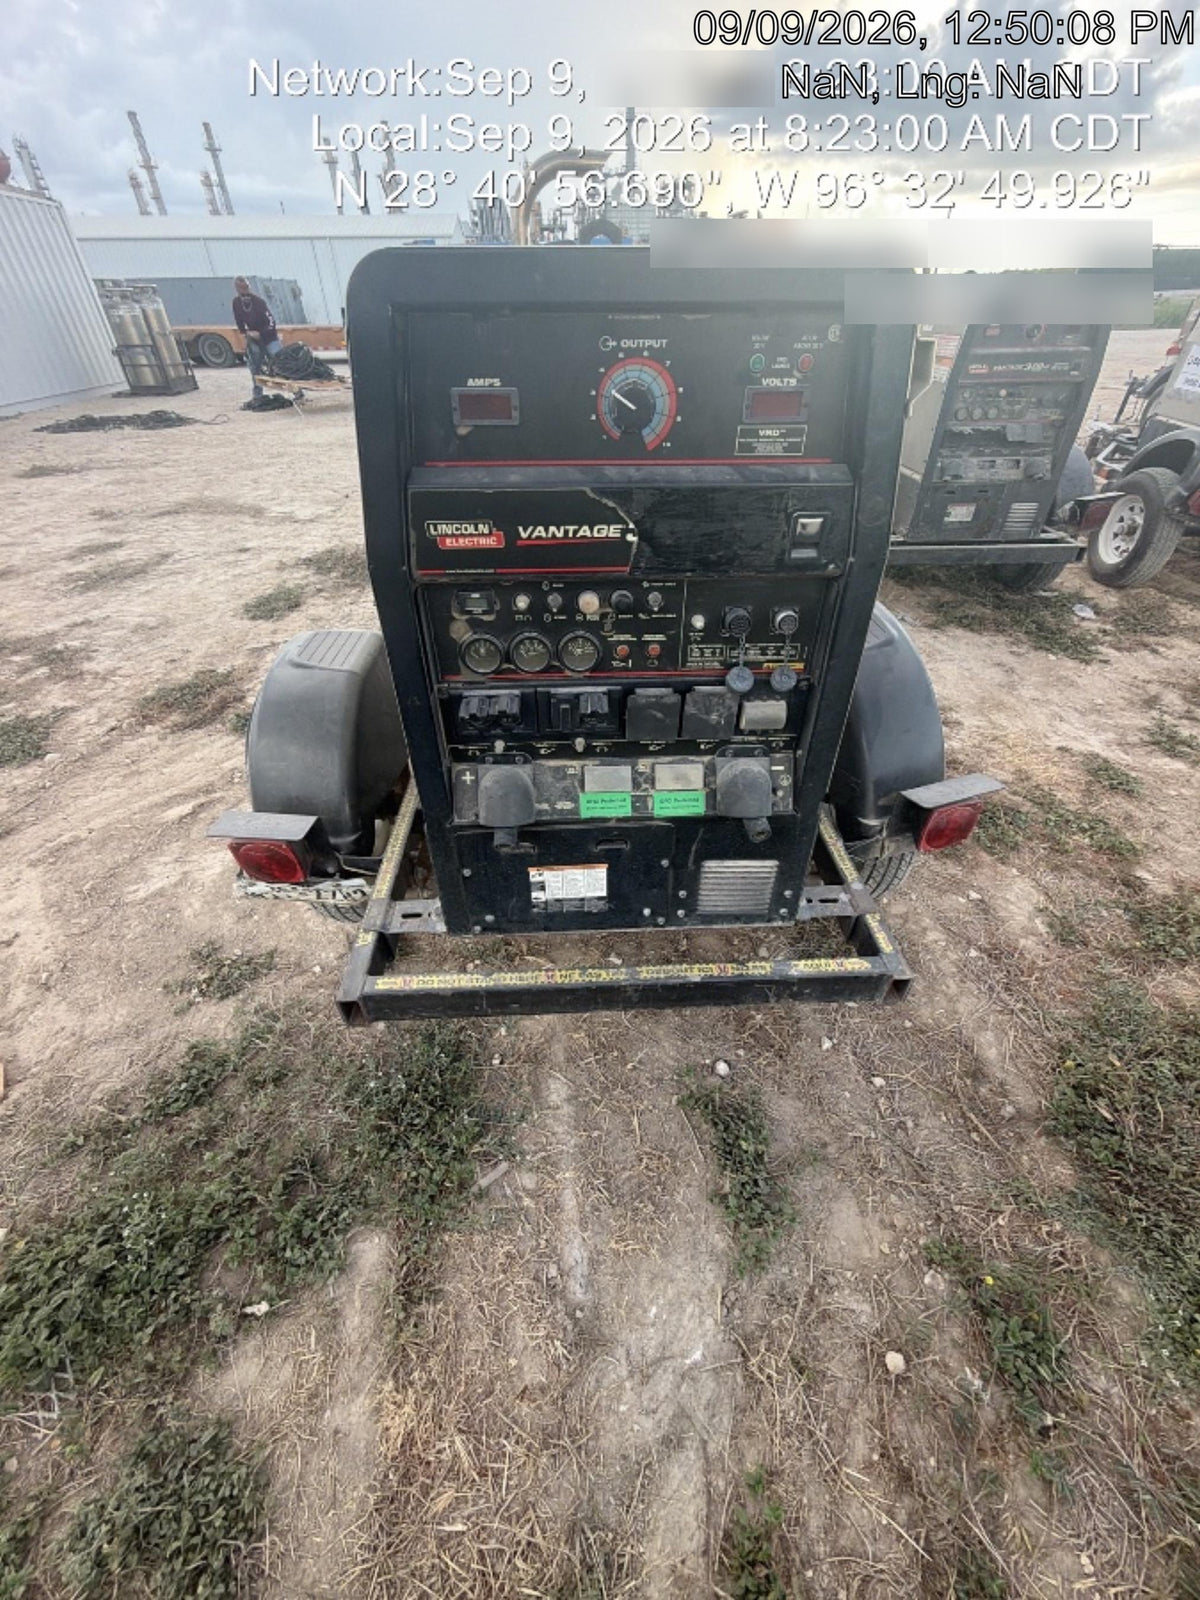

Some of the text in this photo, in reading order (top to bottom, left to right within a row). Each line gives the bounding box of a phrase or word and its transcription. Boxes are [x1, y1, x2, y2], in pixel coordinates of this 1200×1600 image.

[620, 339, 668, 348] OUTPUT
[467, 378, 502, 387] AMPS
[762, 378, 798, 387] VOLTS
[429, 523, 490, 535] LINCOLN
[517, 524, 622, 539] VANTAGE
[445, 536, 497, 547] ELECTRIC
